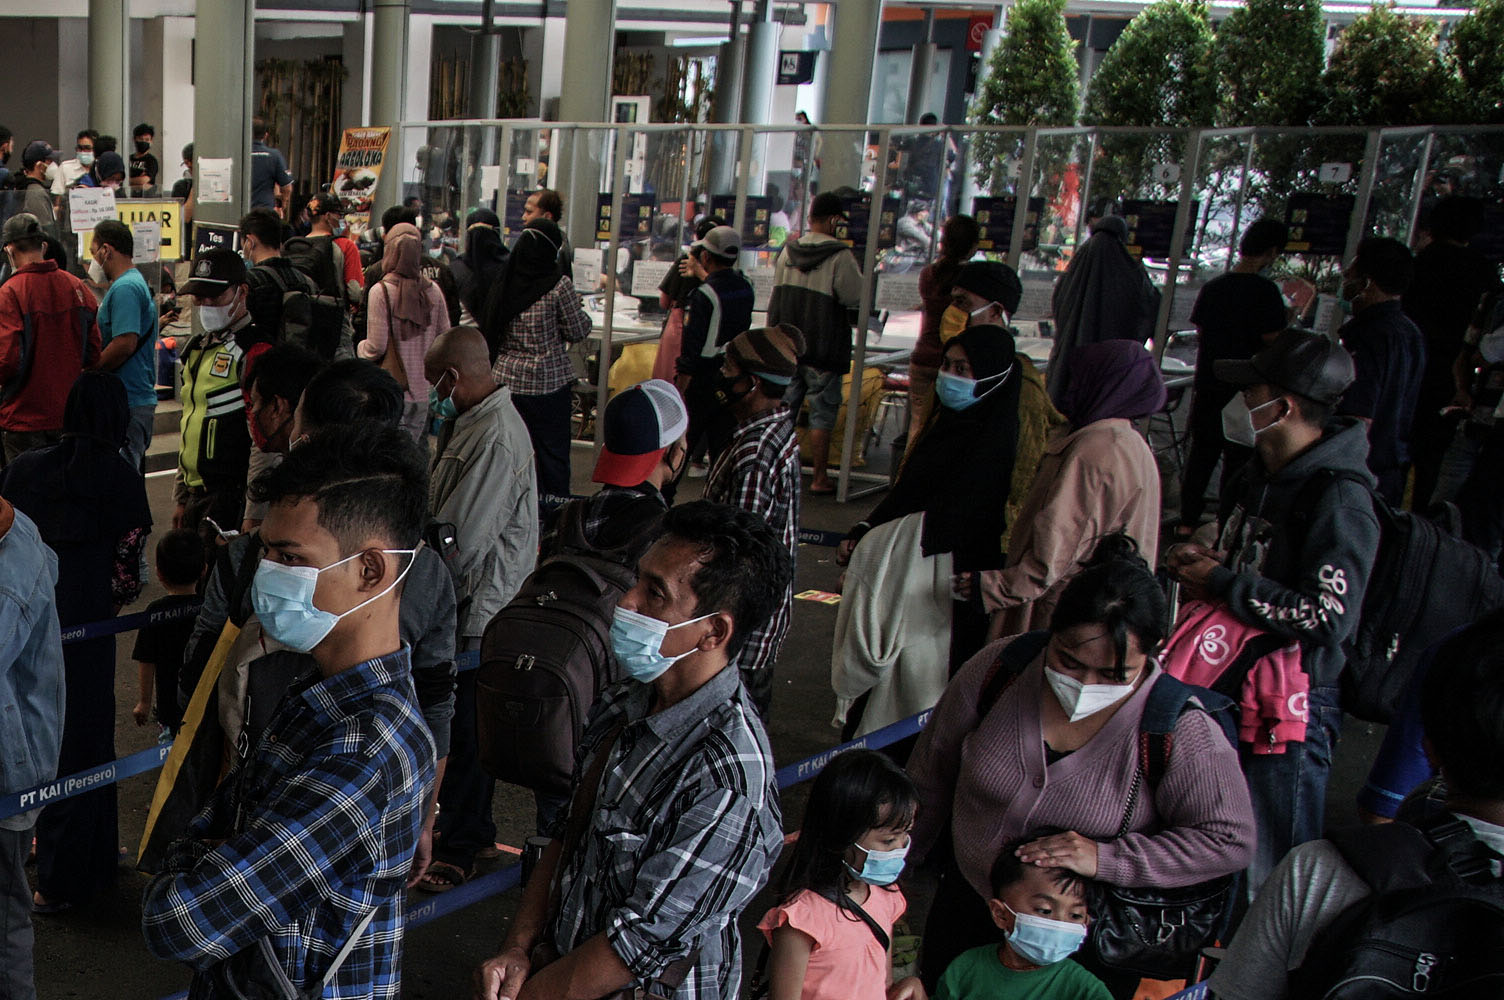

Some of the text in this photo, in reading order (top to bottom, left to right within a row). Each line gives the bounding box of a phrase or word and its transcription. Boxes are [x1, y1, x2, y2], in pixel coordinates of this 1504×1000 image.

[1162, 168, 1171, 179] 6
[1331, 167, 1339, 178] 7
[119, 211, 172, 228] LUAR
[208, 231, 224, 243] Tes
[61, 628, 86, 641] sero)
[917, 712, 929, 727] PT
[798, 756, 828, 778] PT KAI
[19, 766, 116, 807] PT KAI (Persero)
